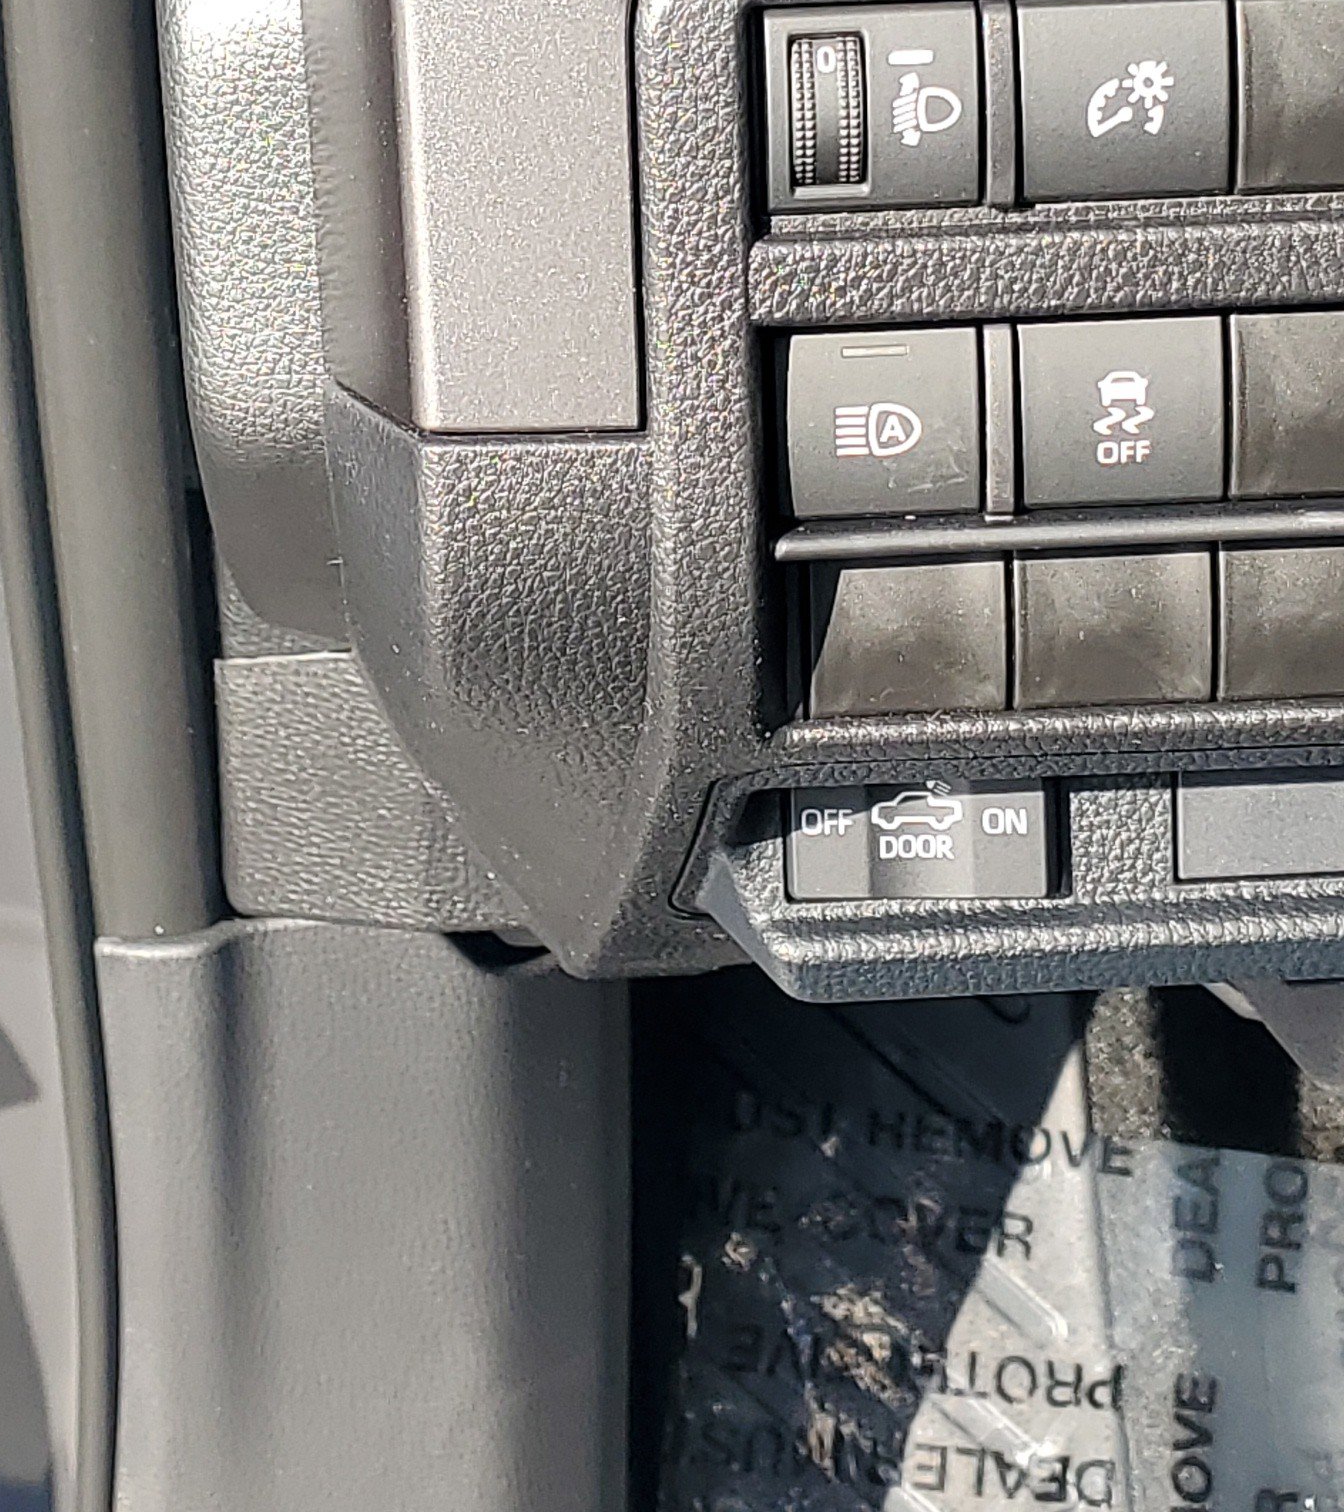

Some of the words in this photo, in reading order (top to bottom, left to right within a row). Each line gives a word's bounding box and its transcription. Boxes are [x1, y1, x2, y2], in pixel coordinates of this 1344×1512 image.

[817, 45, 838, 74] 0
[1096, 439, 1152, 465] OFF
[800, 808, 855, 837] OFF
[980, 806, 1029, 836] ON
[878, 834, 956, 861] DOOR
